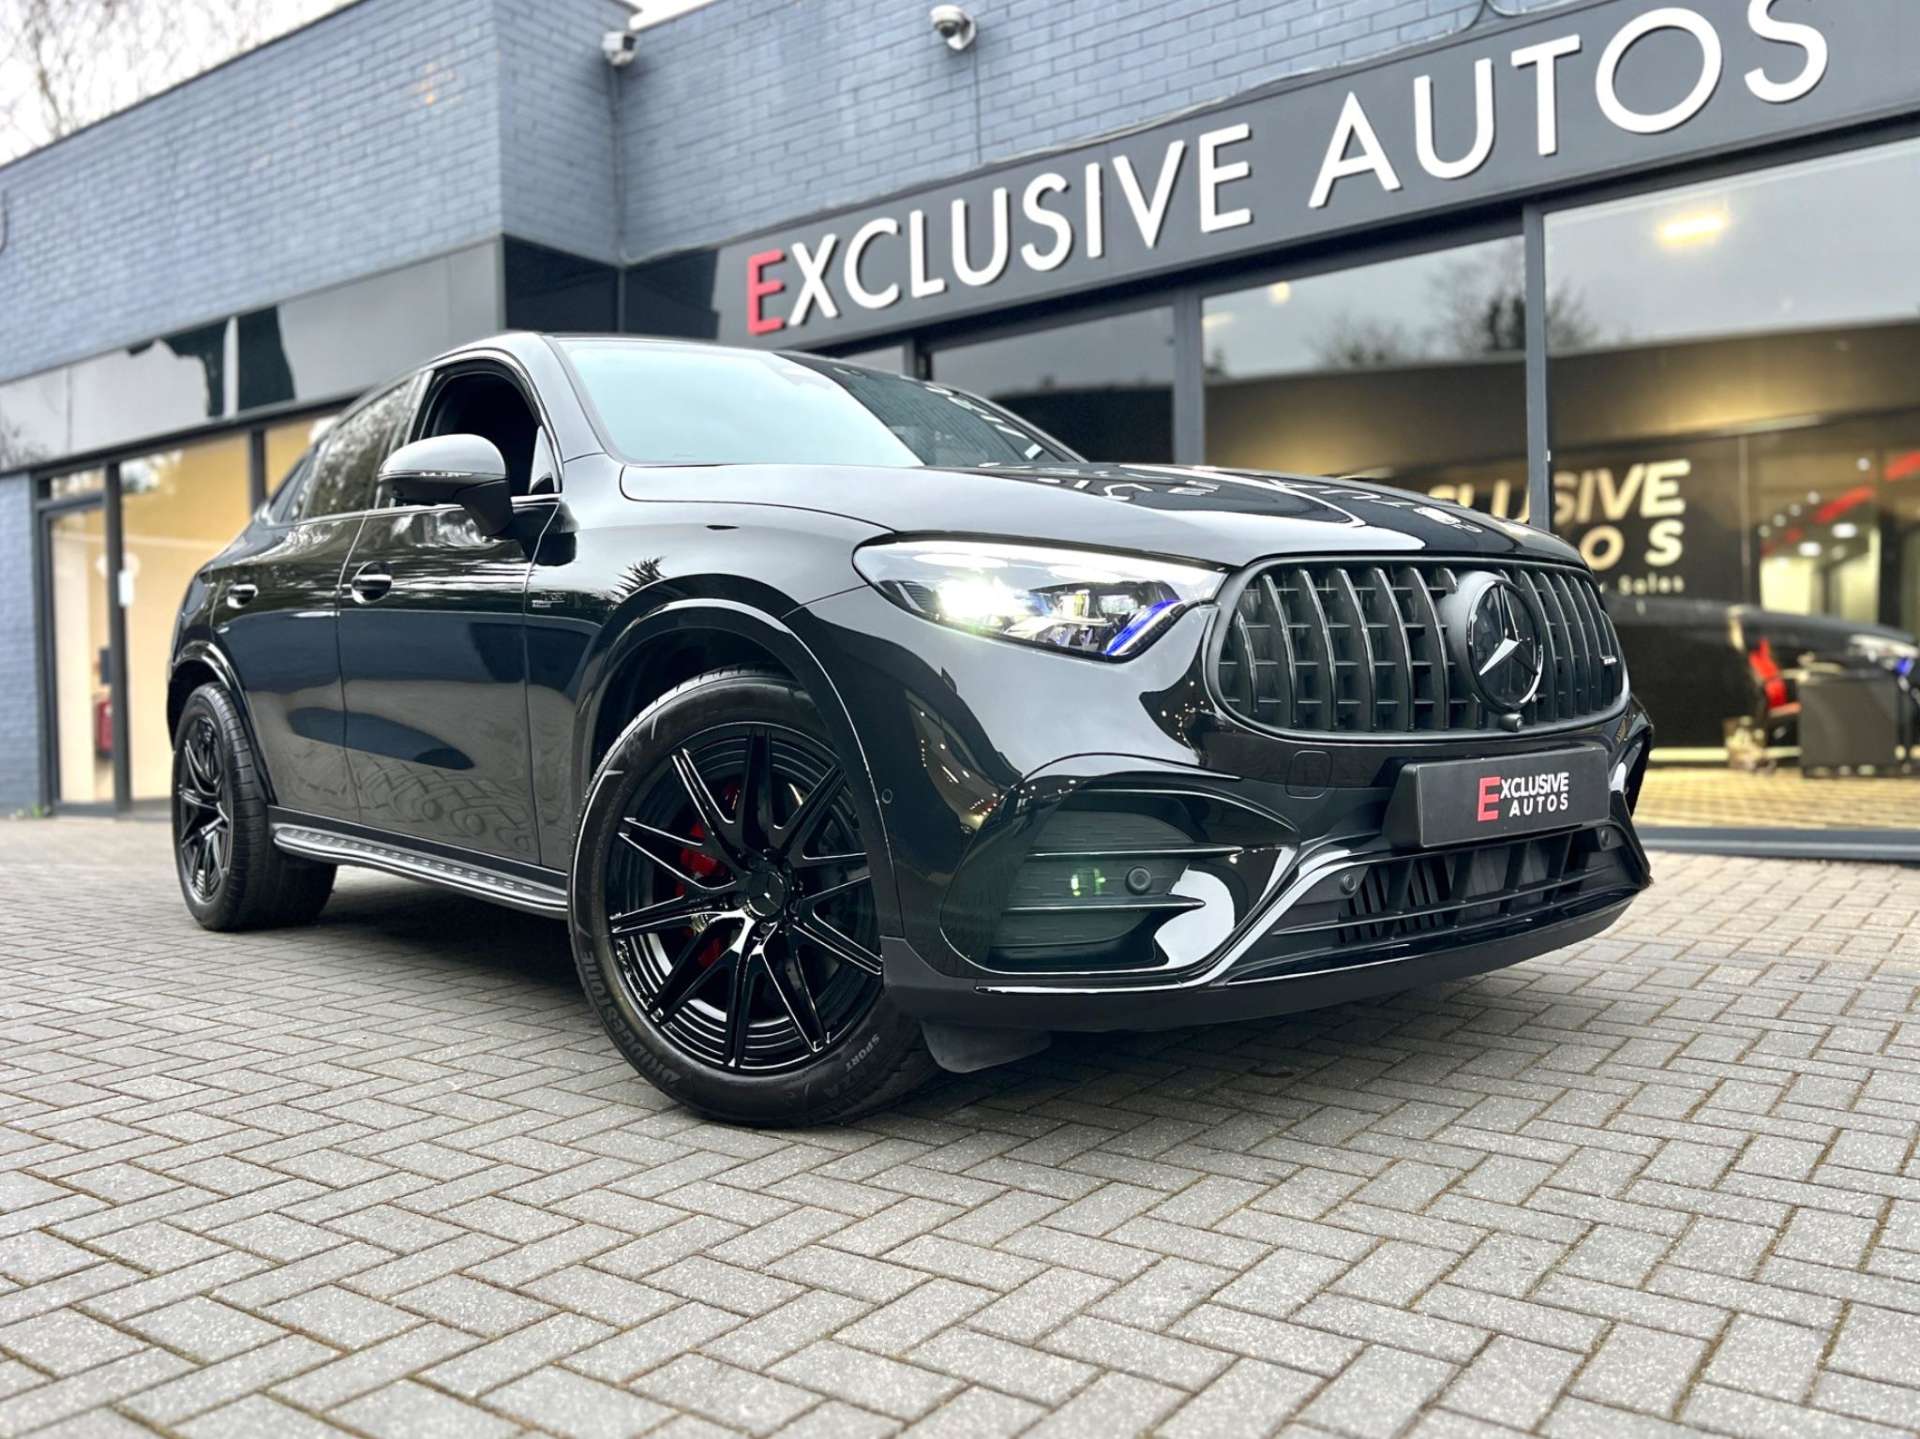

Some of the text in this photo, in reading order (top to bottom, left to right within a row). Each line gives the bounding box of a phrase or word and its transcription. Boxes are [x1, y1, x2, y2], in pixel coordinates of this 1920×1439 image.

[747, 0, 1829, 336] EXCLUSIVE AUTOS
[1477, 772, 1570, 822] EXCLUSIVE
[1508, 793, 1569, 818] AUTOS
